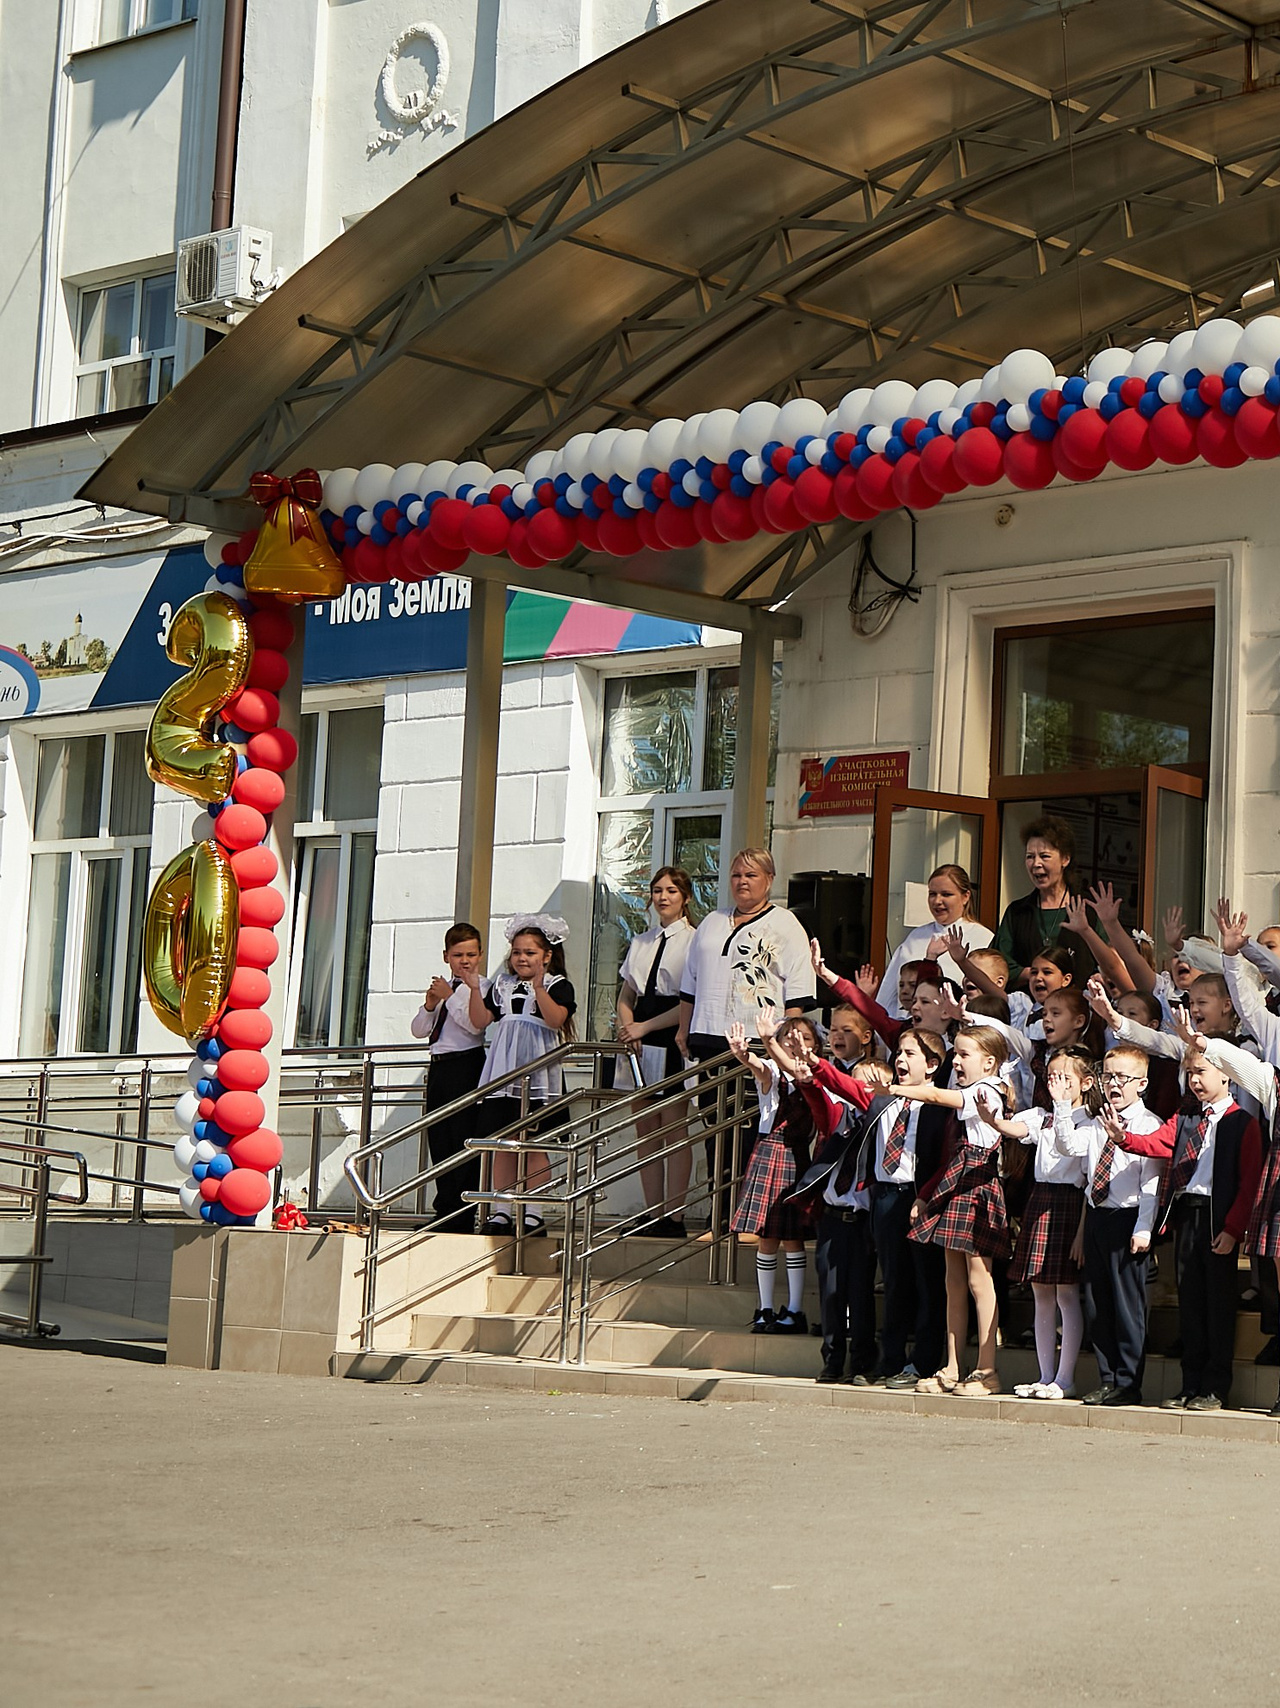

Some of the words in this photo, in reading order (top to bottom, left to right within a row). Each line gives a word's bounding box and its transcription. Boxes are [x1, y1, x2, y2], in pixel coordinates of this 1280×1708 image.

[329, 583, 382, 625] Моя
[388, 577, 472, 618] Земля
[838, 758, 897, 770] УЧАСТКОВАЯ
[830, 769, 905, 782] ИЗБИРАТЕЛЬНАЯ
[851, 798, 874, 807] УЧАСТК
